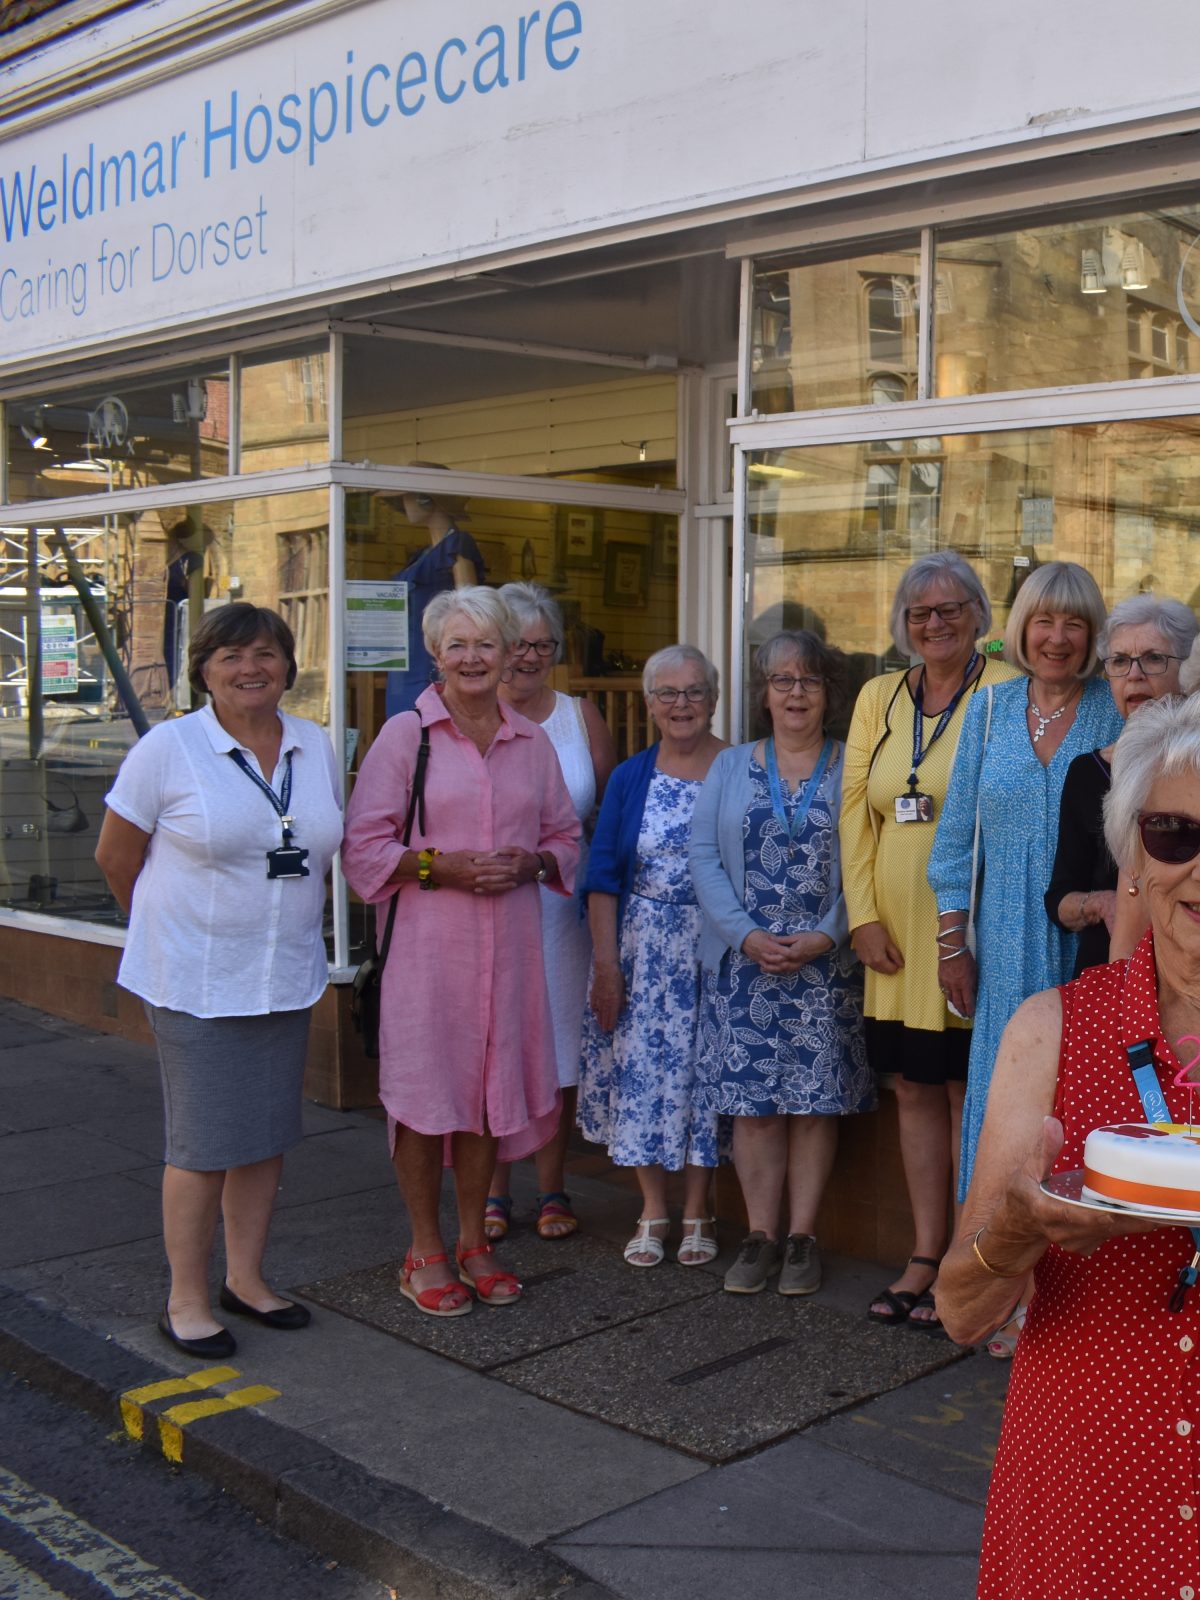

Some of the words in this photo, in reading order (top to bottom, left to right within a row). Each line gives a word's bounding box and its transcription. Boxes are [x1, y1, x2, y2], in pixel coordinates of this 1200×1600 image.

[0, 131, 188, 244] Weldmar
[203, 0, 583, 180] Hospicecare
[0, 259, 88, 321] Caring
[98, 238, 141, 294] for
[151, 194, 269, 282] Dorset
